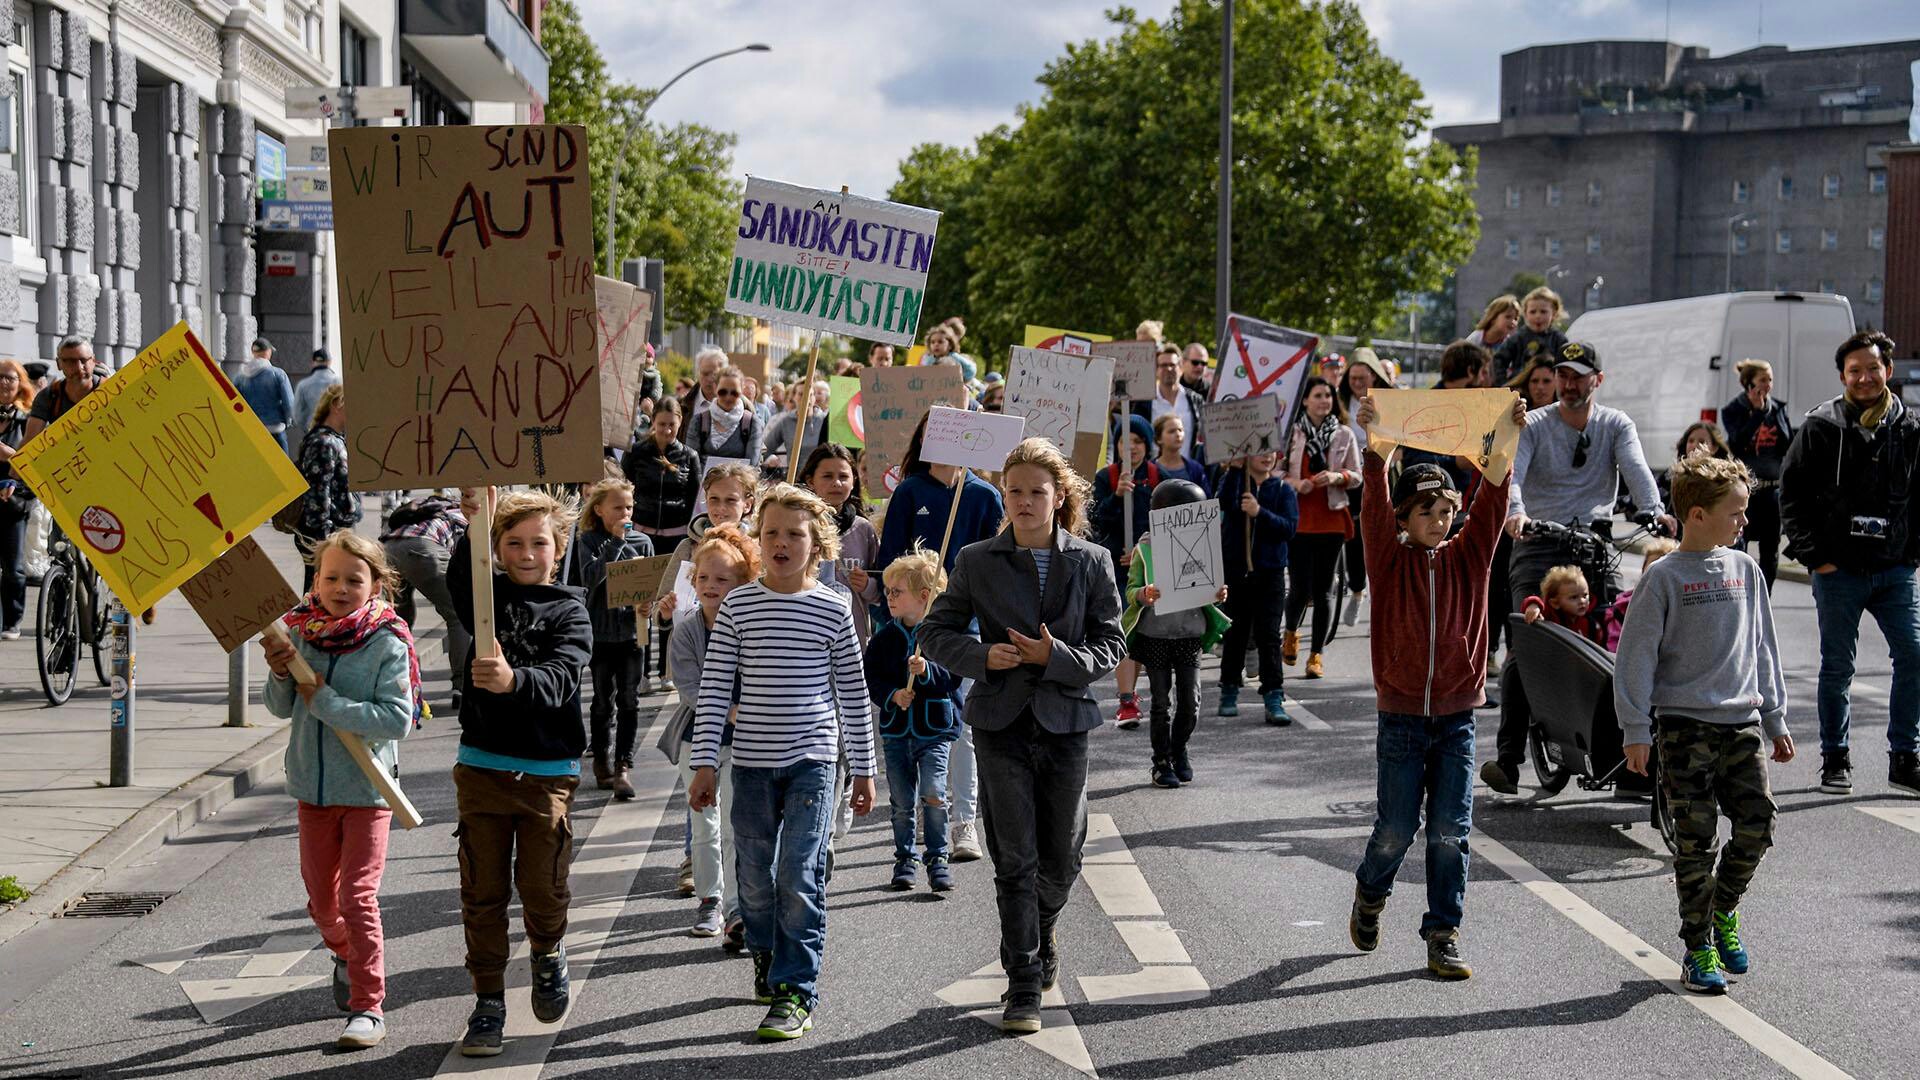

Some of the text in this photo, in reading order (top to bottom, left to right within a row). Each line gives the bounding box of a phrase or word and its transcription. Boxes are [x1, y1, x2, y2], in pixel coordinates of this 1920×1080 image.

[405, 176, 574, 256] LAUT
[738, 199, 935, 274] SANDKASTEN
[813, 199, 840, 215] AM
[729, 256, 924, 335] HANDYFASTEN
[350, 324, 445, 374] NUR
[11, 429, 57, 485] FLUG
[138, 348, 164, 377] AN
[37, 444, 93, 507] JETZT
[159, 347, 192, 381] DRAN
[416, 354, 595, 428] HANDY
[114, 396, 225, 528] HANDY
[356, 414, 565, 483] SCHAUT
[121, 517, 191, 606] AUS
[608, 563, 638, 580] KIND
